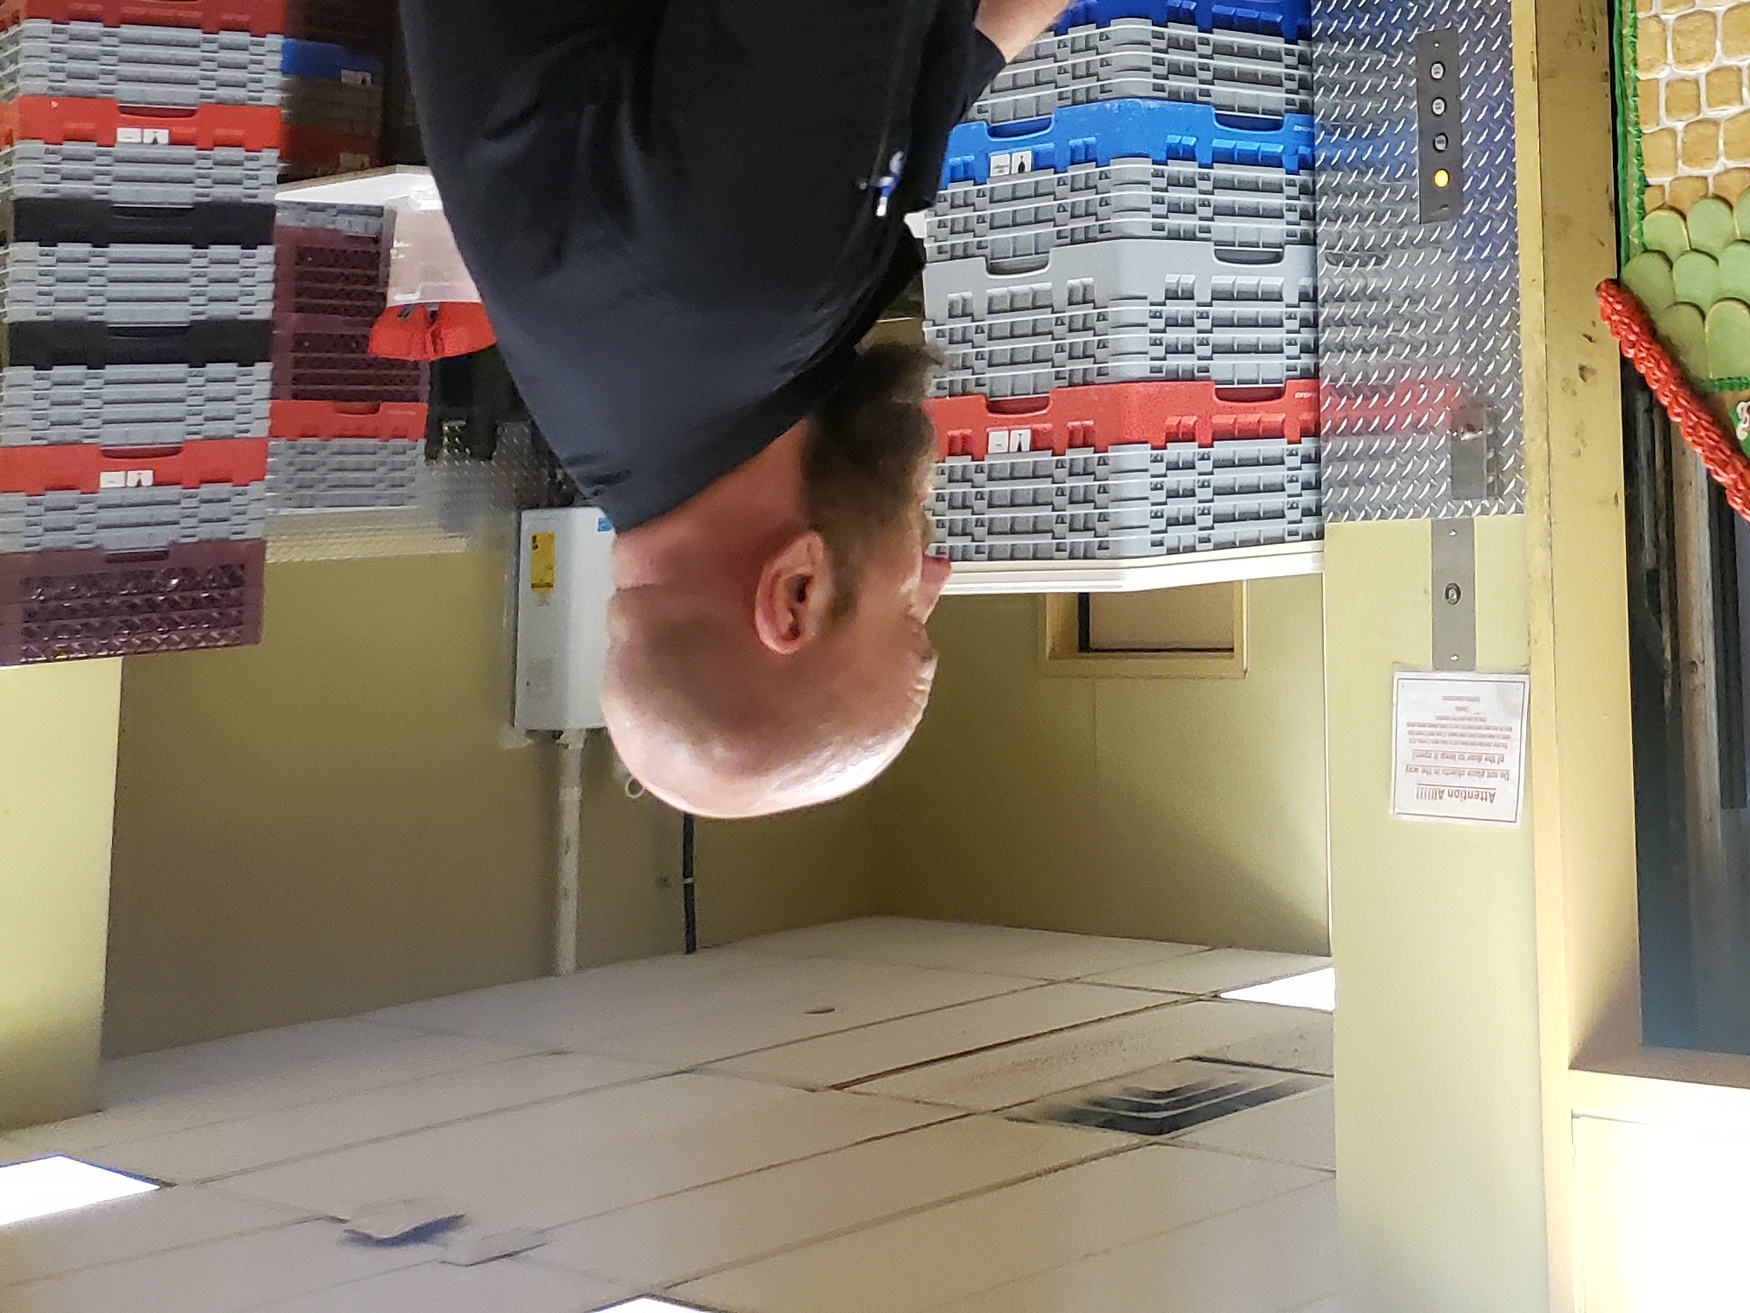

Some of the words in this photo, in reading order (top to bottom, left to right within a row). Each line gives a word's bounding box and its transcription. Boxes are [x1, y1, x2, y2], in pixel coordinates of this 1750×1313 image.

[1440, 752, 1456, 761] keep
[1467, 755, 1482, 763] door
[1485, 755, 1496, 764] the
[1497, 755, 1504, 765] of
[1405, 765, 1419, 773] way
[1421, 768, 1432, 776] the
[1442, 768, 1465, 778] objects
[1467, 770, 1485, 779] place
[1500, 772, 1509, 781] Do
[1448, 789, 1496, 804] Attention
